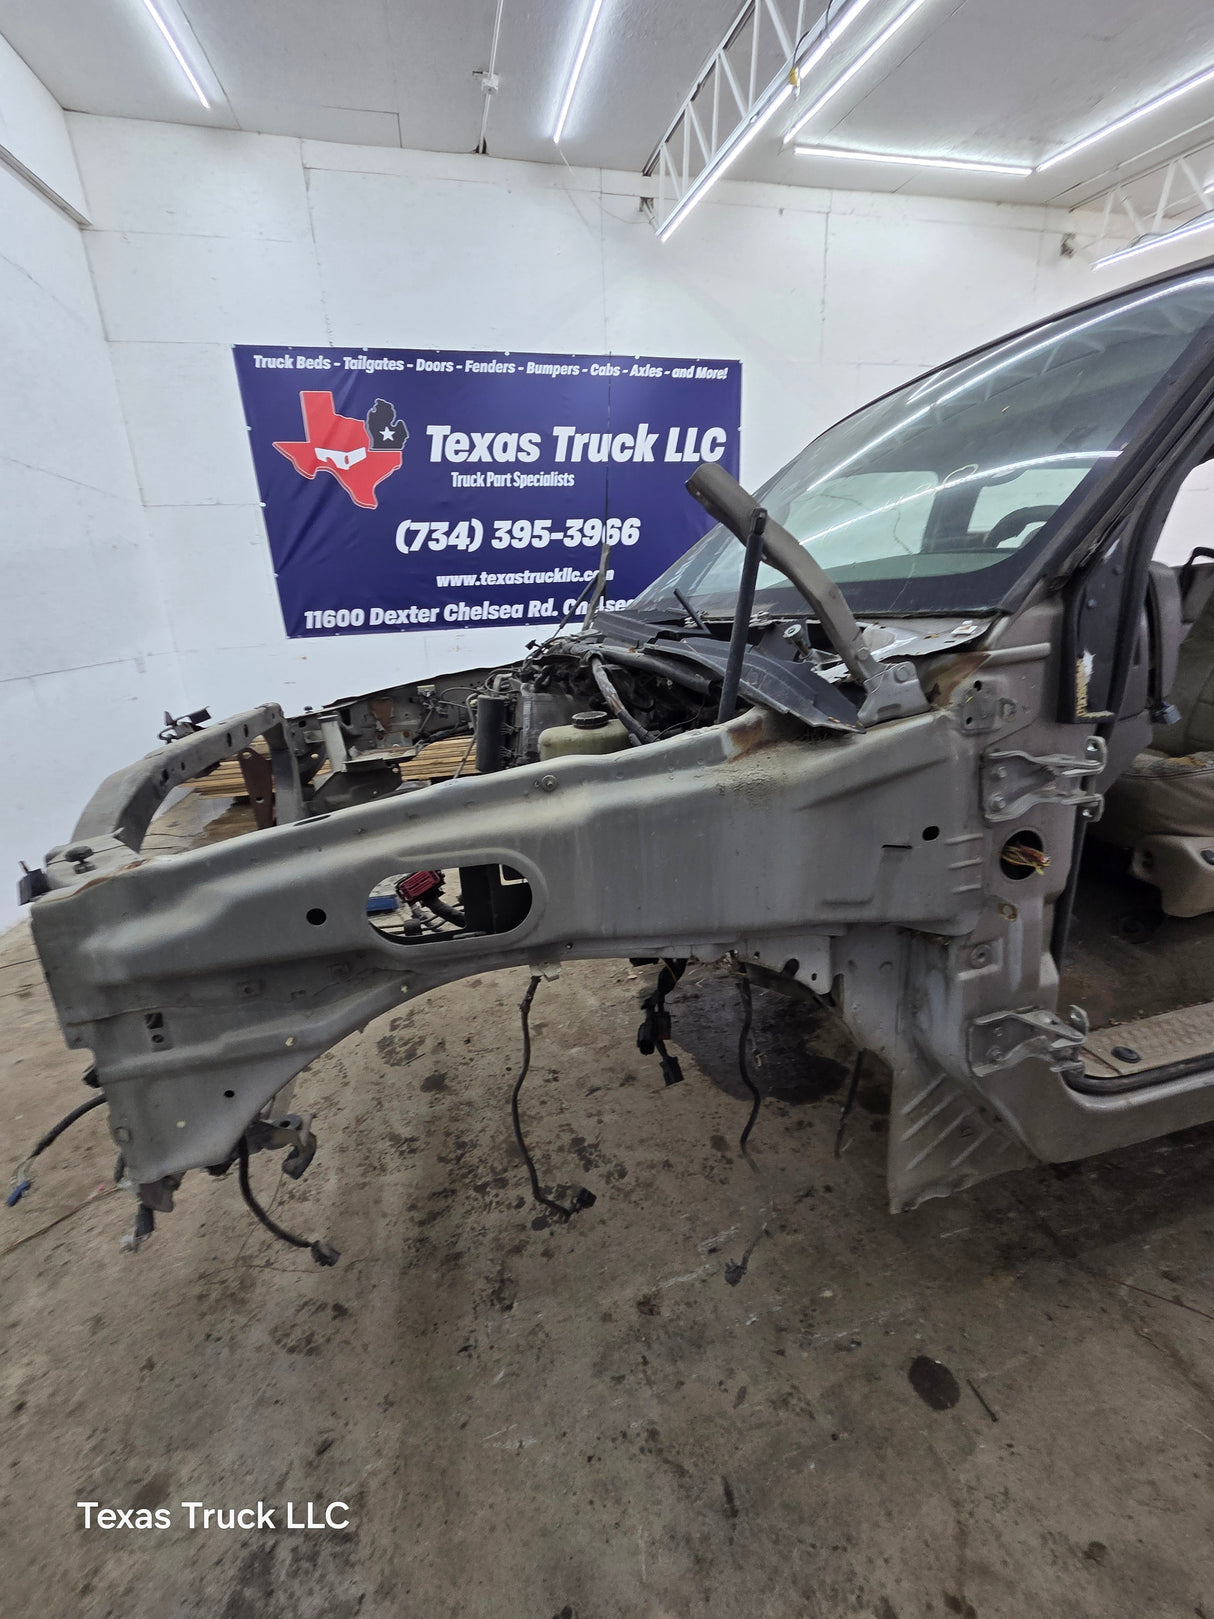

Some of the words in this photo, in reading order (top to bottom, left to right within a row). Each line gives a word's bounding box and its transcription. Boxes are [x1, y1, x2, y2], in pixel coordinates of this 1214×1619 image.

[254, 355, 294, 368] Truck
[297, 356, 331, 369] Beds
[343, 355, 404, 373] Tailgates
[416, 359, 453, 372] Doors
[465, 360, 515, 373] Fenders
[526, 362, 580, 377] Bumpers
[590, 363, 620, 376] Cabs
[629, 364, 663, 377] Axles
[672, 366, 694, 378] and
[694, 366, 728, 379] More!
[427, 425, 541, 462] Texas
[553, 424, 659, 462] Truck
[664, 427, 726, 462] LLC
[451, 472, 484, 487] Truck
[487, 472, 512, 486] Part
[513, 472, 574, 488] Specialists
[396, 519, 483, 553] (734)
[491, 517, 641, 549] 395-3966
[305, 609, 364, 628] 11600
[370, 606, 439, 625] Dexter
[444, 601, 524, 621] Chelsea
[528, 598, 558, 617] Rd.
